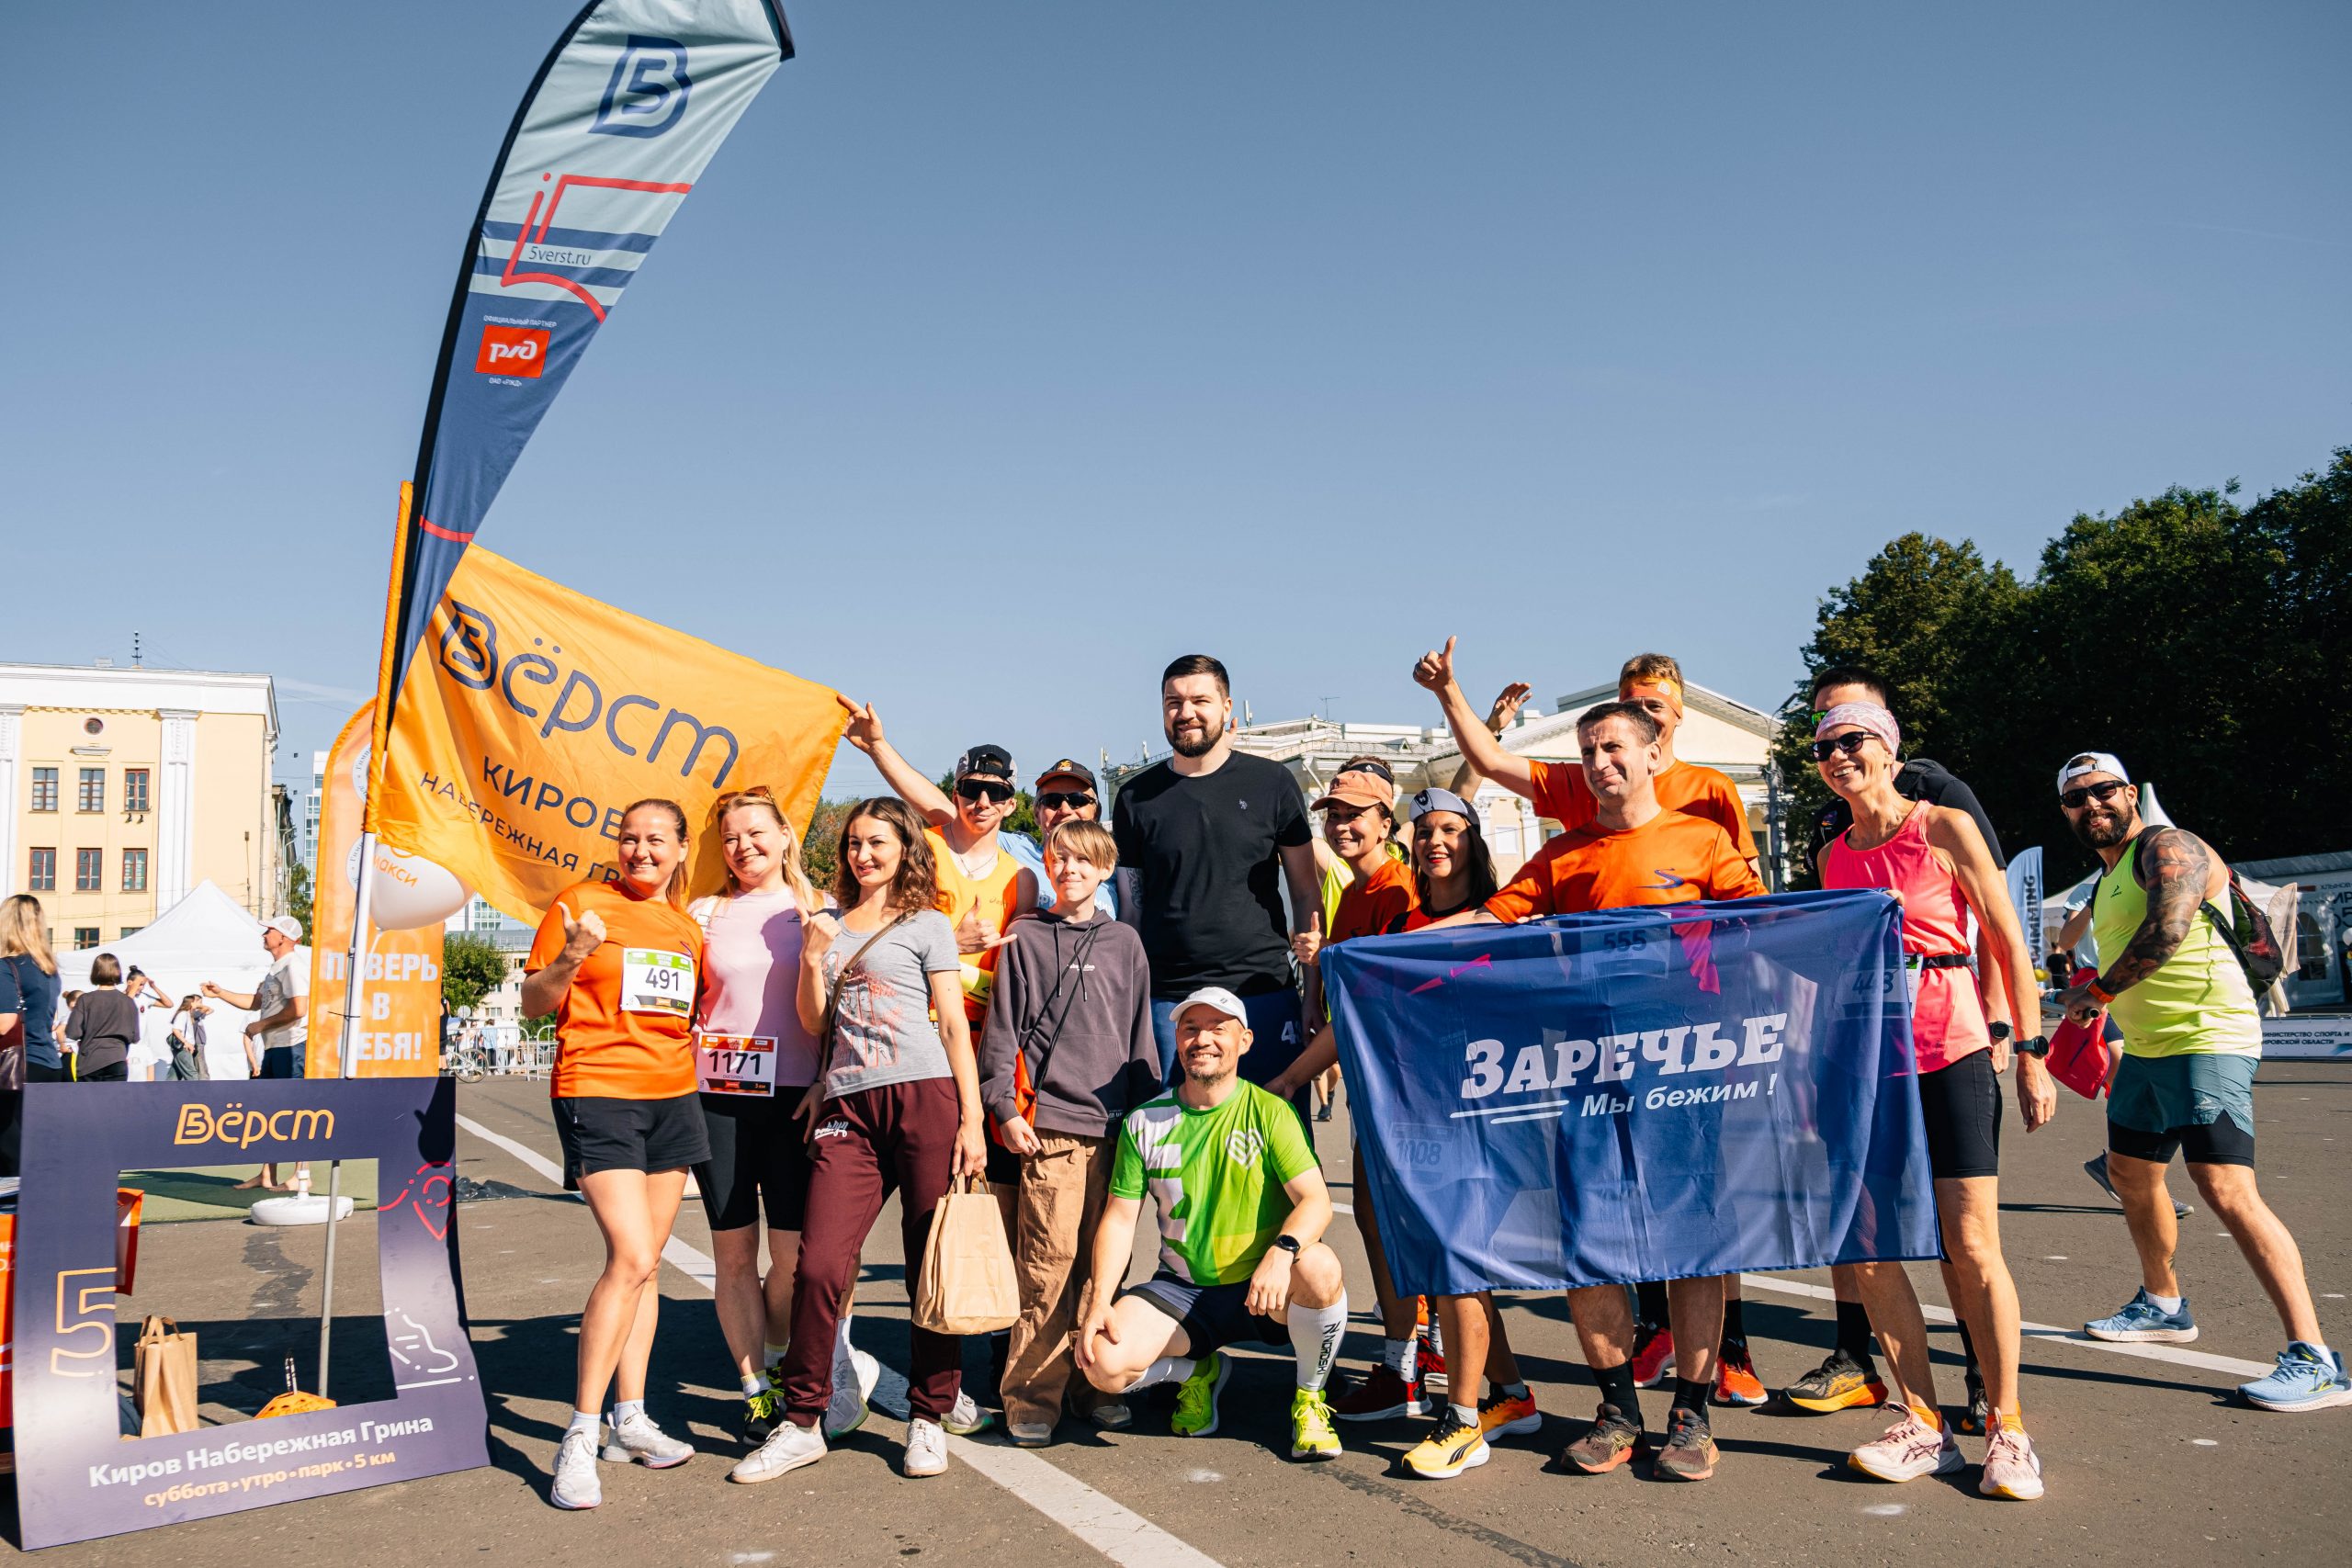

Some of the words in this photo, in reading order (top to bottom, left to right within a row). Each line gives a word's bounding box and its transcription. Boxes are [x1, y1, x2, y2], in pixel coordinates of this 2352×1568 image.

[528, 245, 592, 265] 5verst.ru
[1602, 930, 1647, 953] 555
[325, 952, 438, 982] ПВЕРЬ
[645, 967, 679, 991] 491
[372, 992, 390, 1021] В
[336, 1032, 423, 1061] ЕБЯ!
[1461, 1012, 1788, 1100] ЗАРЕЧЬЕ
[708, 1051, 761, 1076] 1171
[1580, 1093, 1634, 1117] Мы
[1645, 1080, 1759, 1110] бежим
[89, 1458, 182, 1487] Киров
[186, 1428, 357, 1471] Набережная
[359, 1417, 434, 1444] Грина
[144, 1481, 230, 1508] суббота
[240, 1470, 288, 1492] утро
[297, 1460, 345, 1478] парк
[369, 1451, 396, 1466] км
